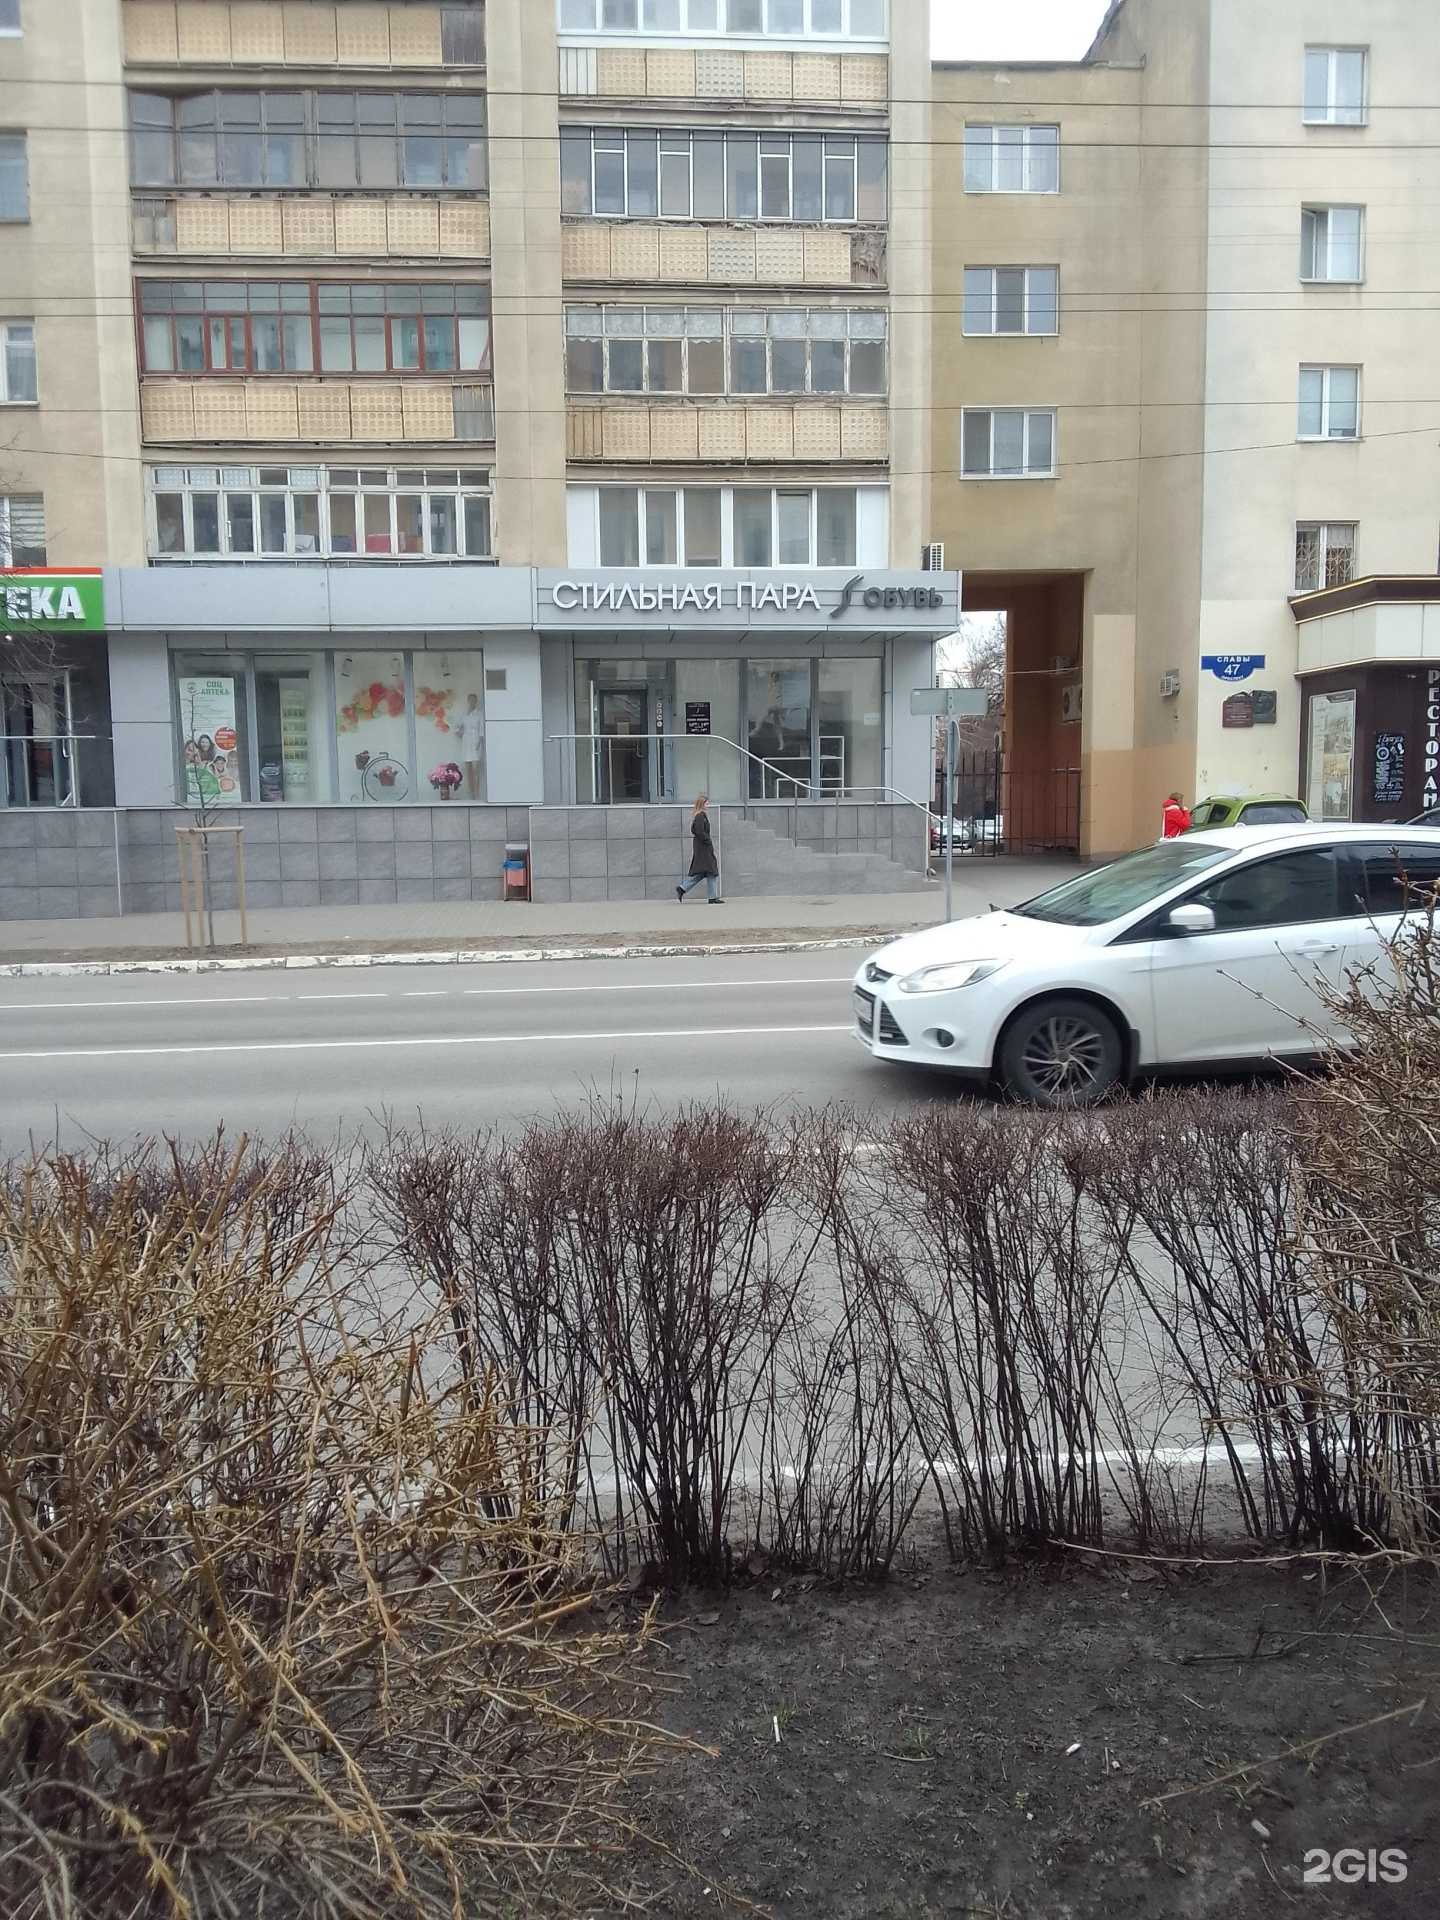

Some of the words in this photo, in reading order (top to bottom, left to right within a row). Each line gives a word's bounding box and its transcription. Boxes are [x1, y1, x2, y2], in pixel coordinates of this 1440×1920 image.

[0, 586, 86, 619] ЕКА
[552, 581, 722, 610] СТИЛЬНАЯ
[736, 581, 820, 610] ПАРА
[863, 586, 944, 608] ОБУВЬ
[1224, 664, 1241, 676] 47
[1423, 669, 1440, 808] РЕСТОРАН
